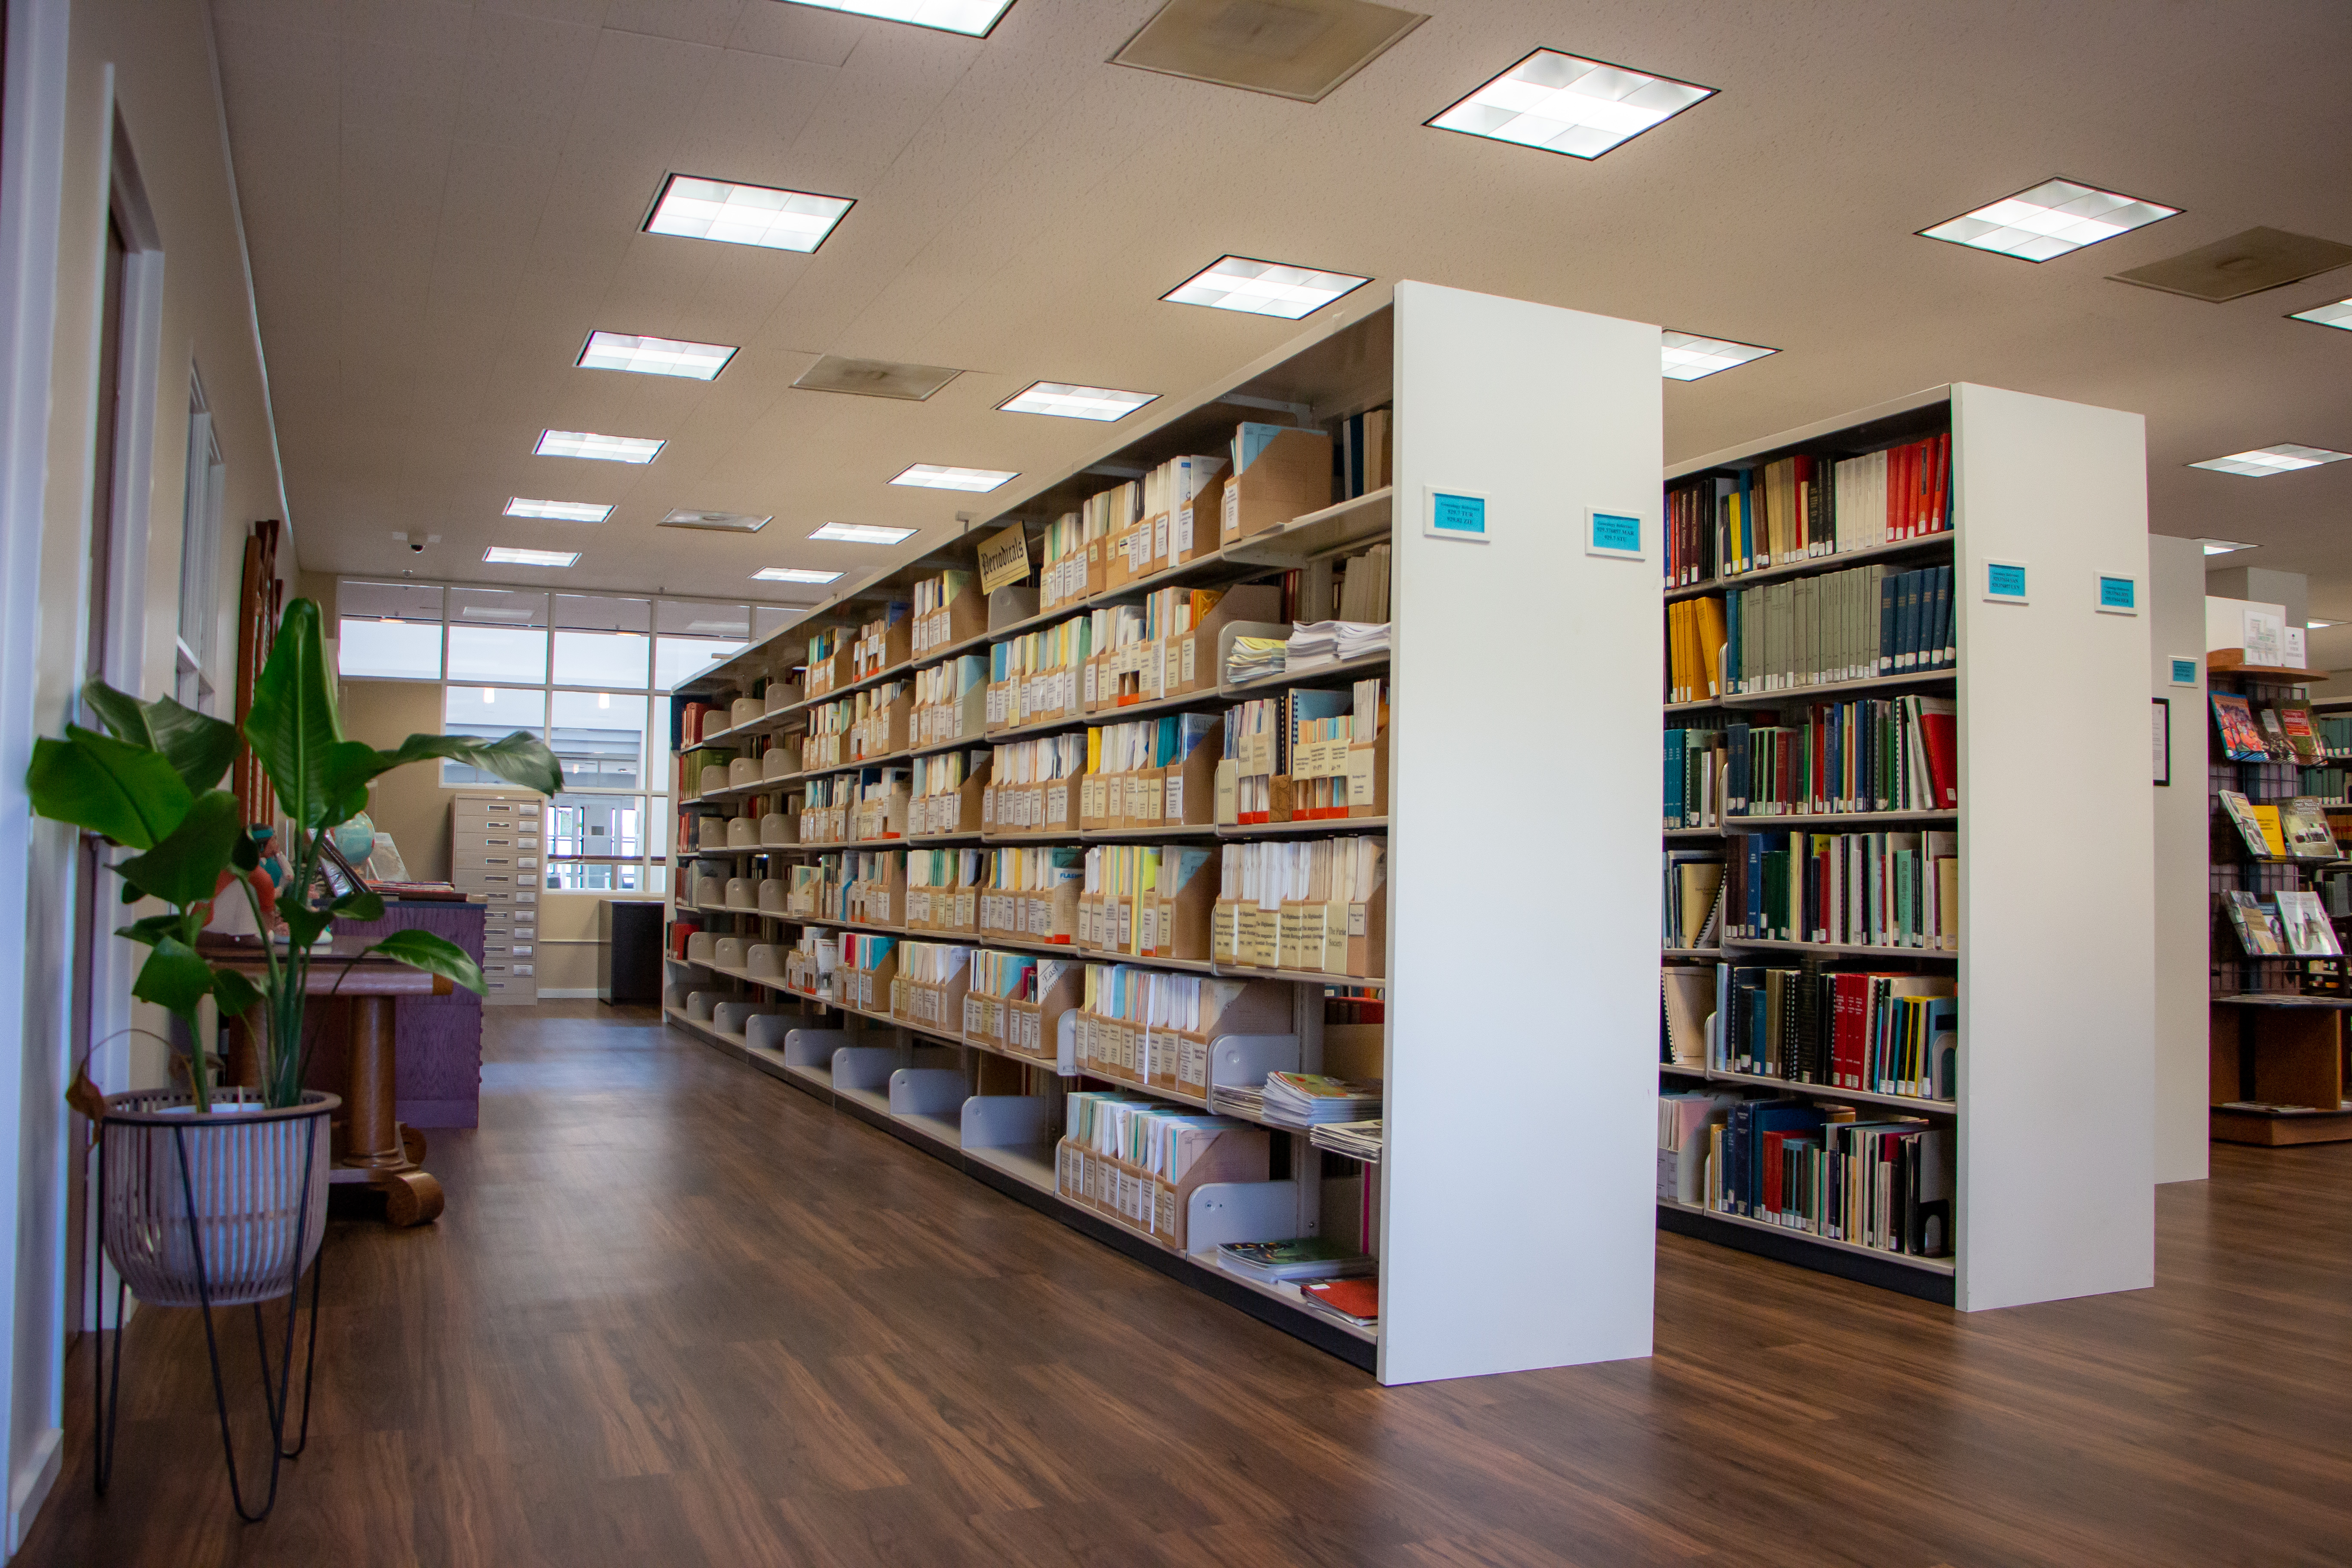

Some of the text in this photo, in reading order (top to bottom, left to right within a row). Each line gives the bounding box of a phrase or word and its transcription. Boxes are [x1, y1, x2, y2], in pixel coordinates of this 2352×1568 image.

[981, 537, 1024, 580] Periodicals
[1329, 938, 1343, 949] Society
[1042, 965, 1058, 983] East
